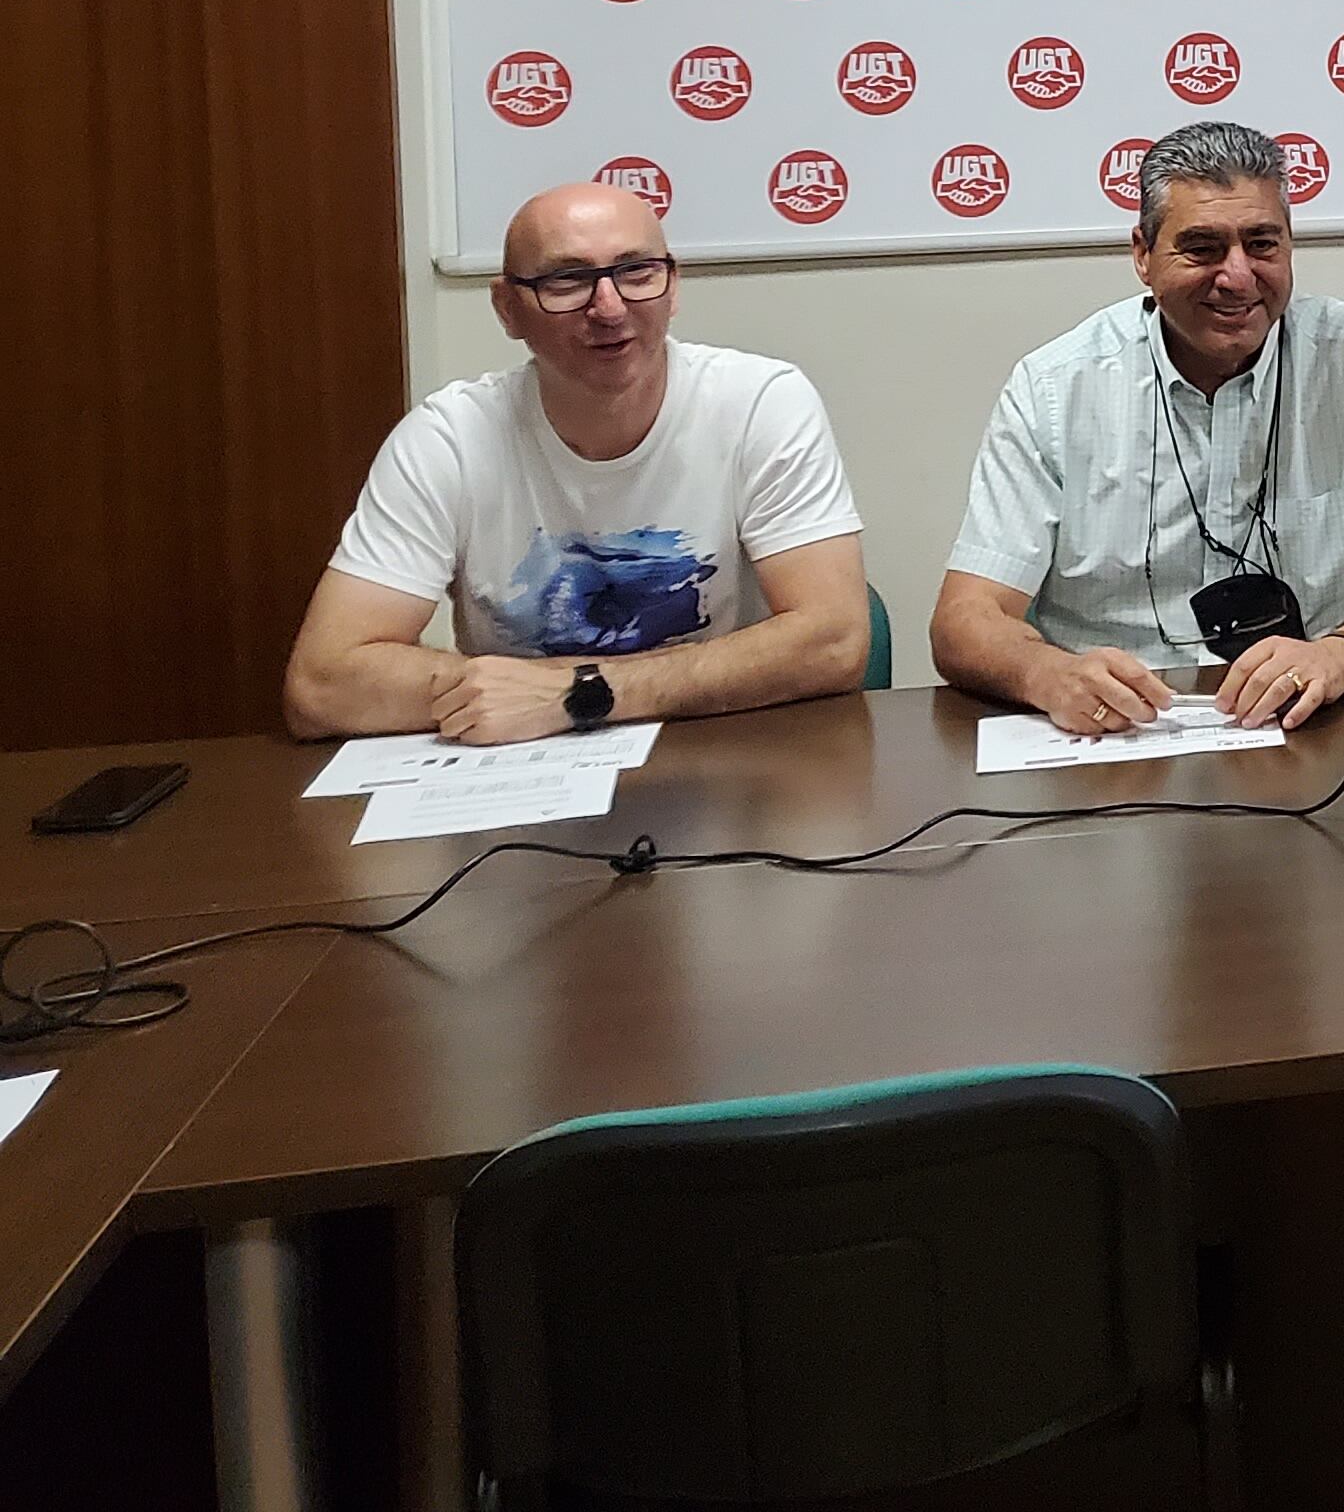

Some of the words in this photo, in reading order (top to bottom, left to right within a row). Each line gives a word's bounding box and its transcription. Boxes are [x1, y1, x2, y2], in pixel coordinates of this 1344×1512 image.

[848, 53, 905, 79] UGT
[1019, 48, 1073, 74] UGT
[1176, 43, 1229, 69] UGT
[499, 62, 559, 90] UGT
[681, 57, 739, 84] UGT
[779, 161, 836, 188] UGT
[942, 155, 998, 181] UGT
[1109, 149, 1142, 176] UG
